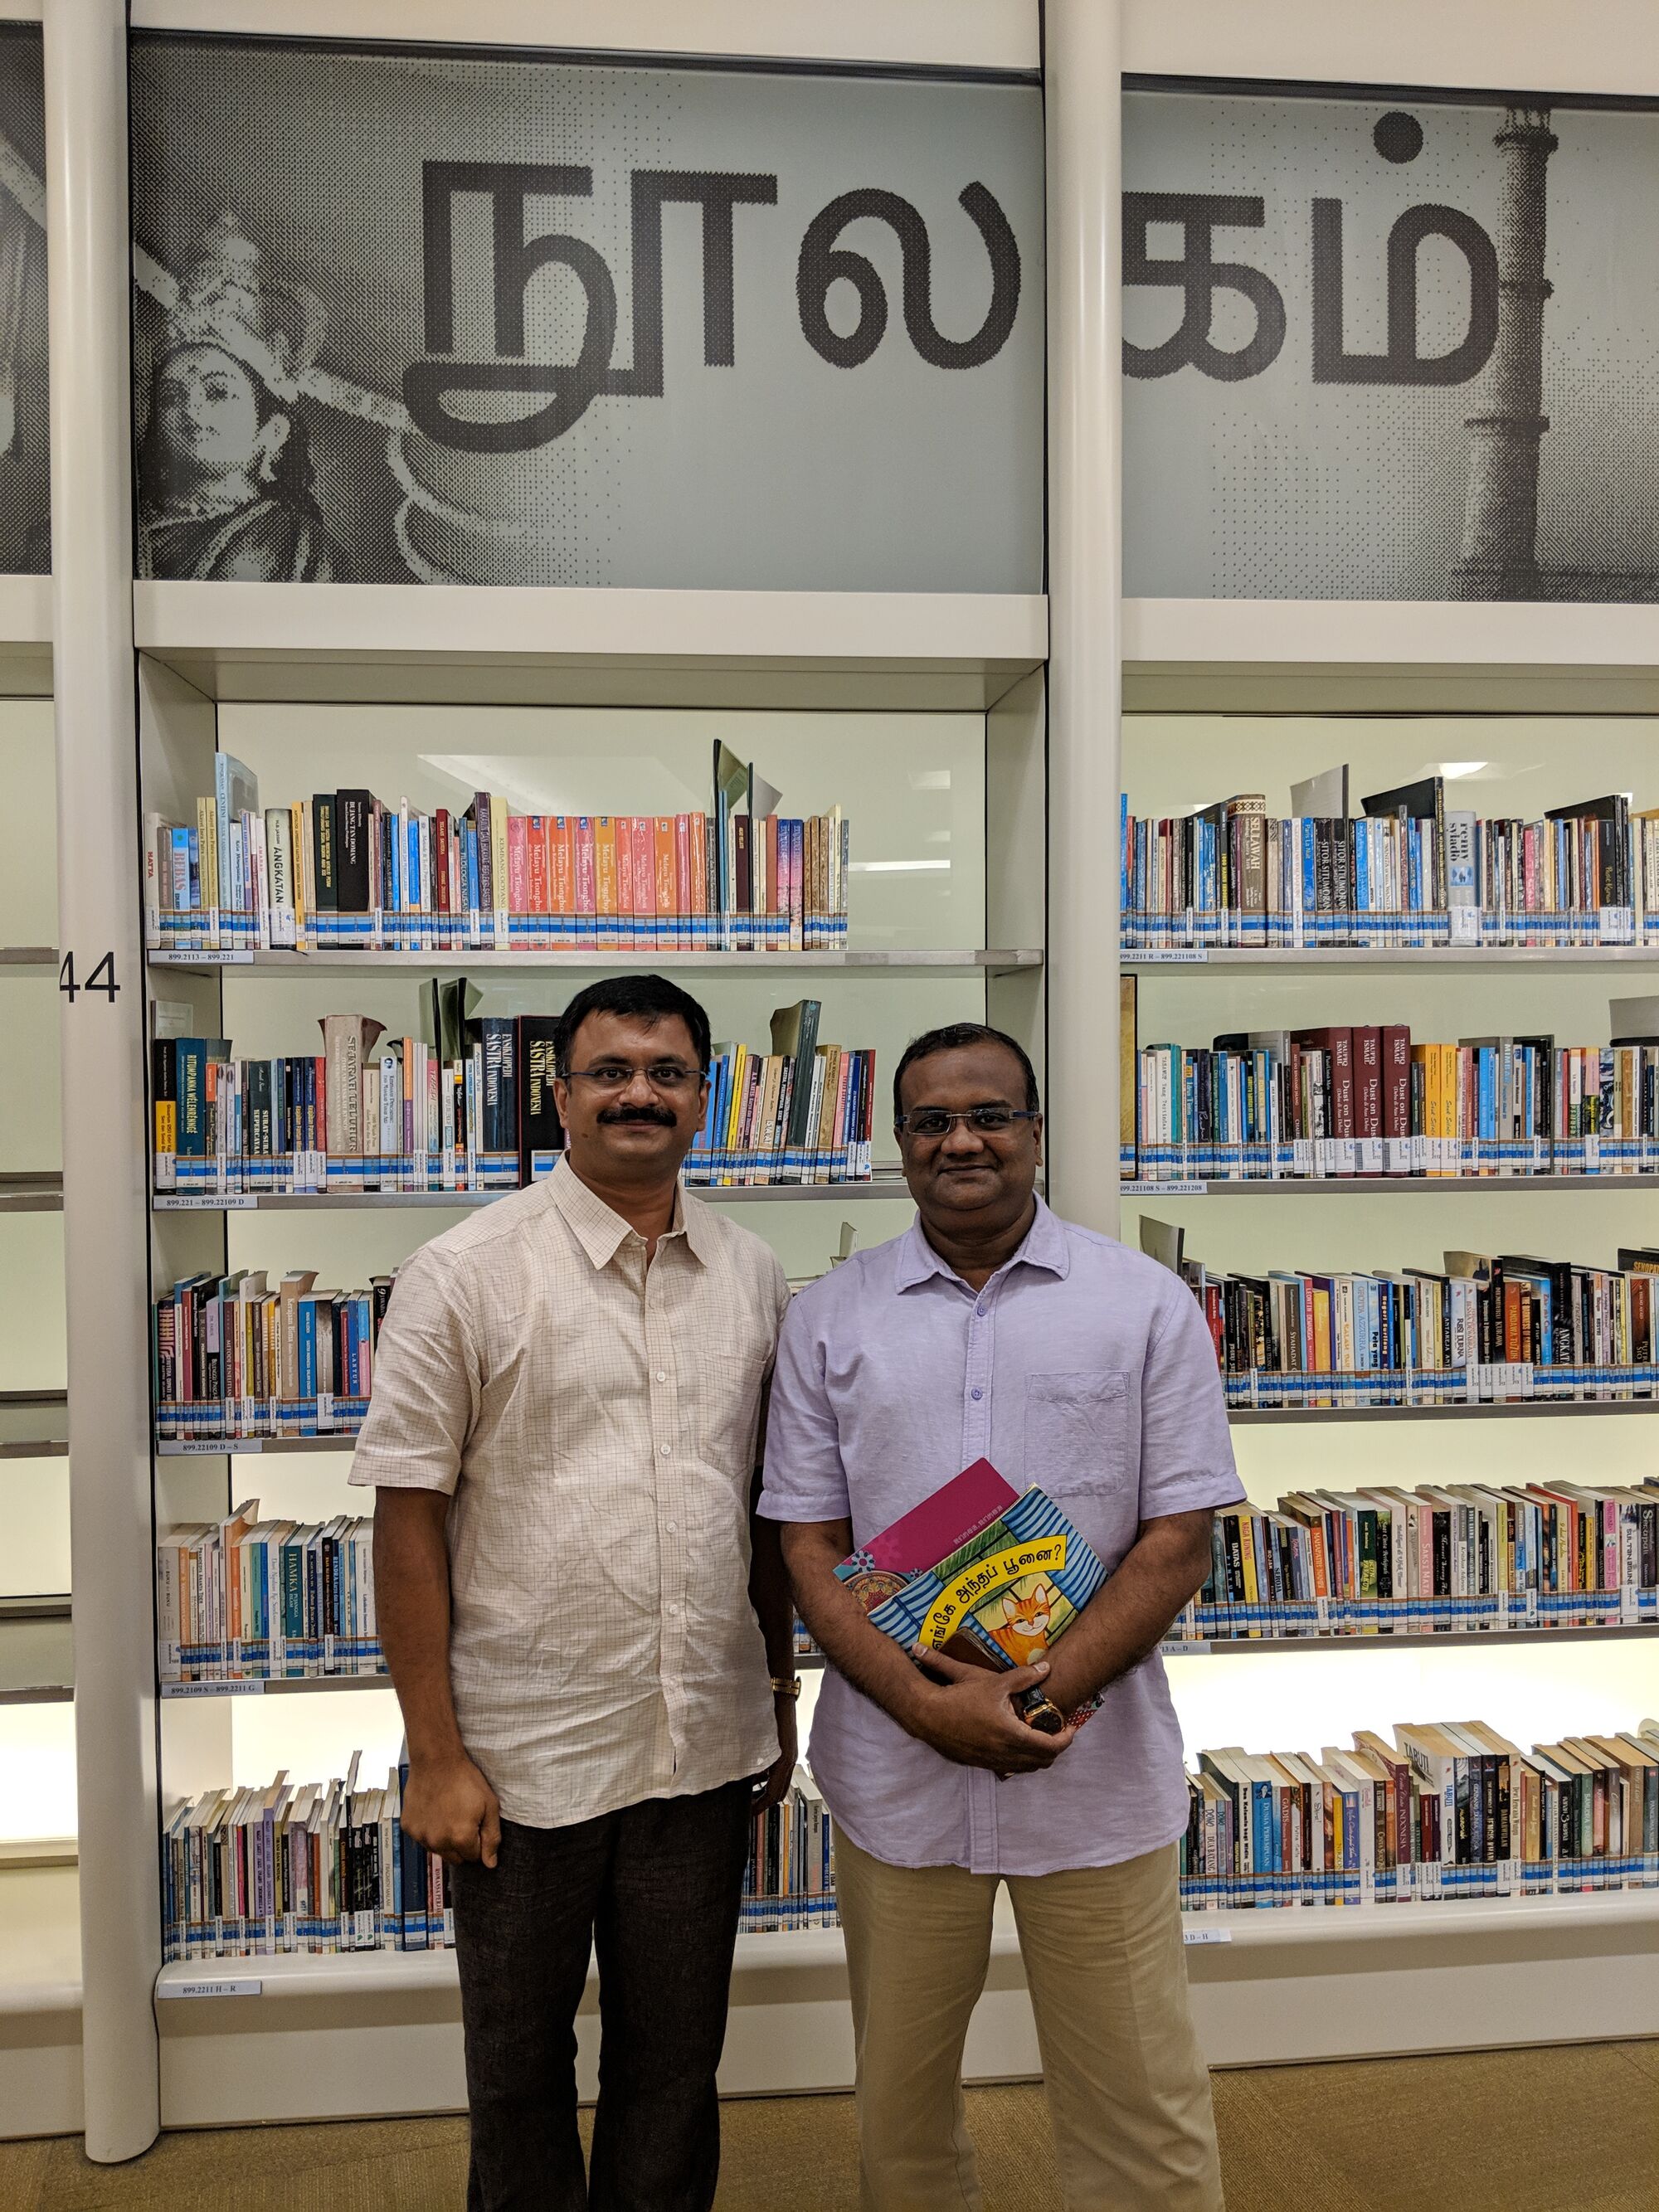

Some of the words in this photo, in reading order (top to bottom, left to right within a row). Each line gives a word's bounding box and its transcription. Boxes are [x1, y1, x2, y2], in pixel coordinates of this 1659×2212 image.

[557, 843, 565, 873] Melayu
[601, 843, 610, 873] Melayu
[1250, 817, 1260, 869] SEULAWAH
[1460, 823, 1469, 861] remy
[273, 847, 285, 902] ANGKATAN
[59, 950, 121, 1003] 44
[348, 1036, 357, 1091] SEJARAH
[486, 1033, 501, 1067] SASTRA
[502, 1034, 512, 1077] ENSIKLOPEDI
[530, 1041, 545, 1077] SASTRA
[187, 1055, 197, 1091] RITUMPANNA
[487, 1071, 498, 1106] INDONESIA
[530, 1078, 541, 1115] INDONESIA
[1343, 1105, 1349, 1115] on
[1370, 1103, 1375, 1114] on
[1400, 1103, 1405, 1113] on
[289, 1553, 297, 1592] HAMKA
[1232, 1543, 1240, 1567] BATAS
[955, 1564, 999, 1603] அந்தப்
[1002, 1544, 1063, 1575] பூனை?
[216, 1685, 246, 1693] 899.2211
[1206, 1809, 1214, 1826] DONO
[182, 1986, 213, 1995] 899.2211
